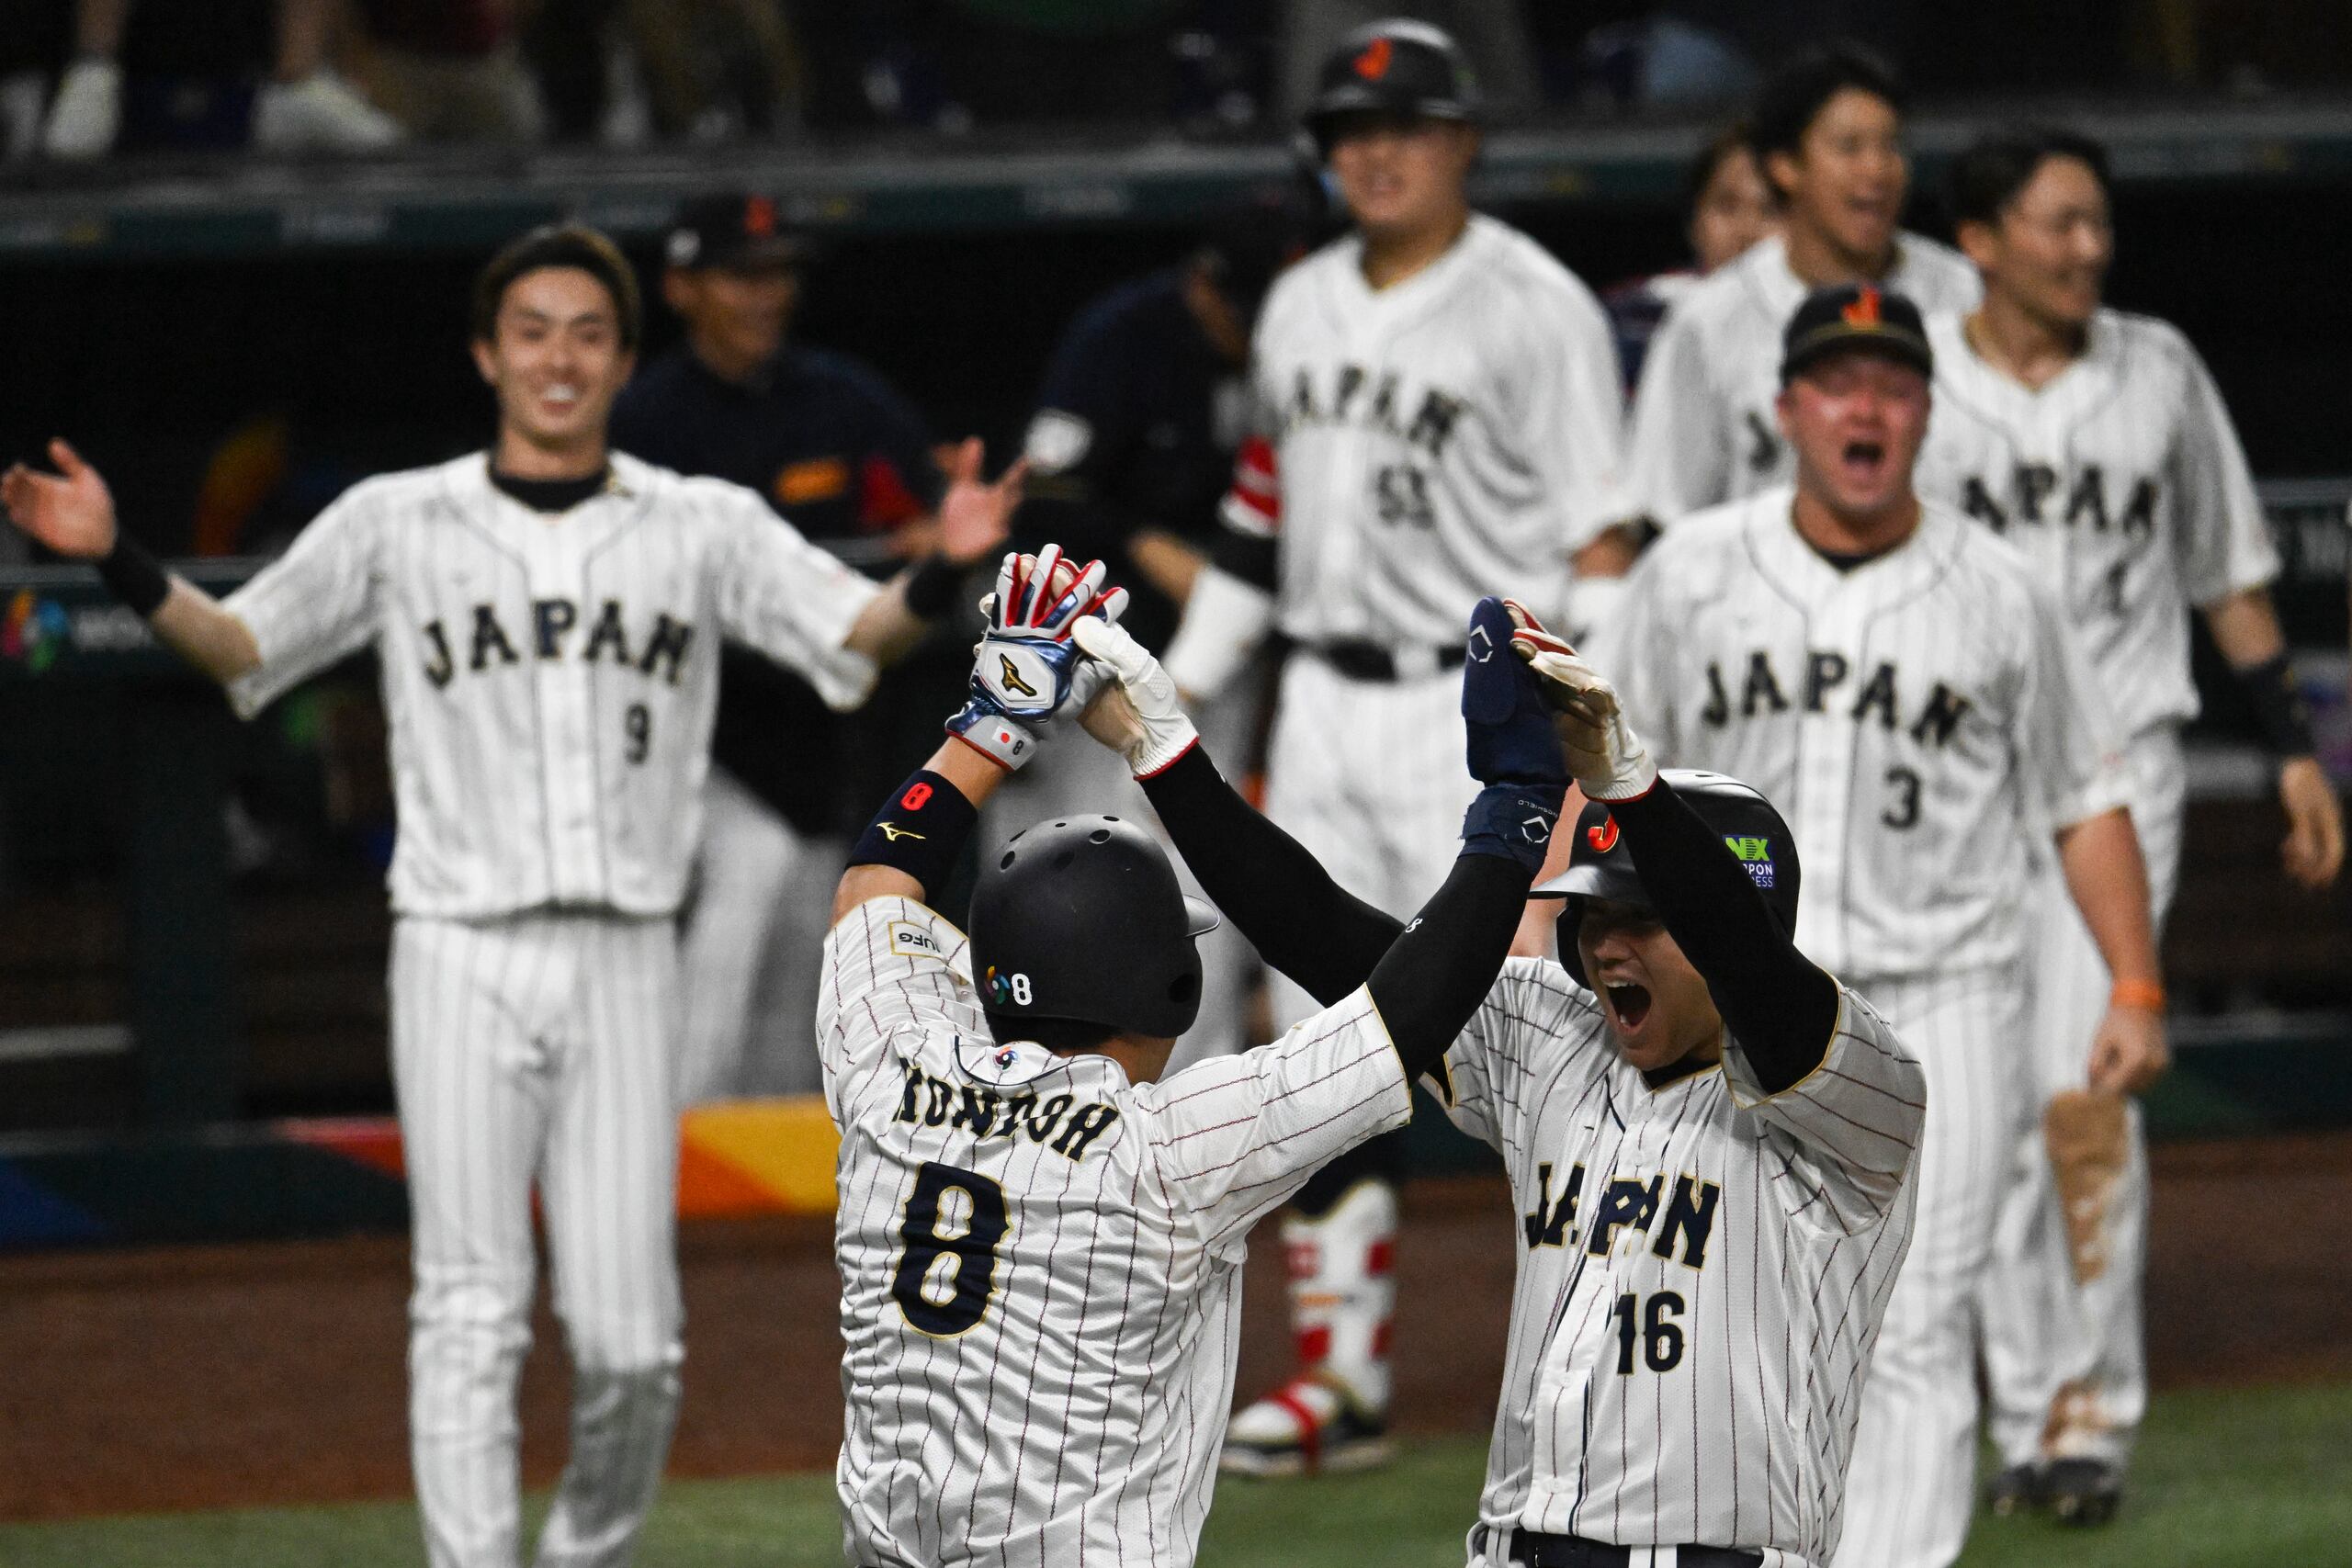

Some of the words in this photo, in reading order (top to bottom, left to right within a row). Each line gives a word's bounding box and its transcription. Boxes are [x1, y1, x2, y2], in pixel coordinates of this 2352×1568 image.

[1840, 286, 1881, 331] J
[1287, 362, 1472, 459] APAN
[415, 597, 695, 691] JAPAN
[1702, 649, 1972, 750] JAPAN
[625, 704, 650, 766] 9
[1012, 739, 1024, 755] 8
[900, 783, 933, 811] 8
[1883, 766, 1922, 829] 3
[1588, 812, 1620, 853] J
[899, 931, 942, 953] UFG
[1011, 972, 1033, 1007] 8
[890, 1160, 1014, 1339] 8
[1611, 1290, 1685, 1376] 16
